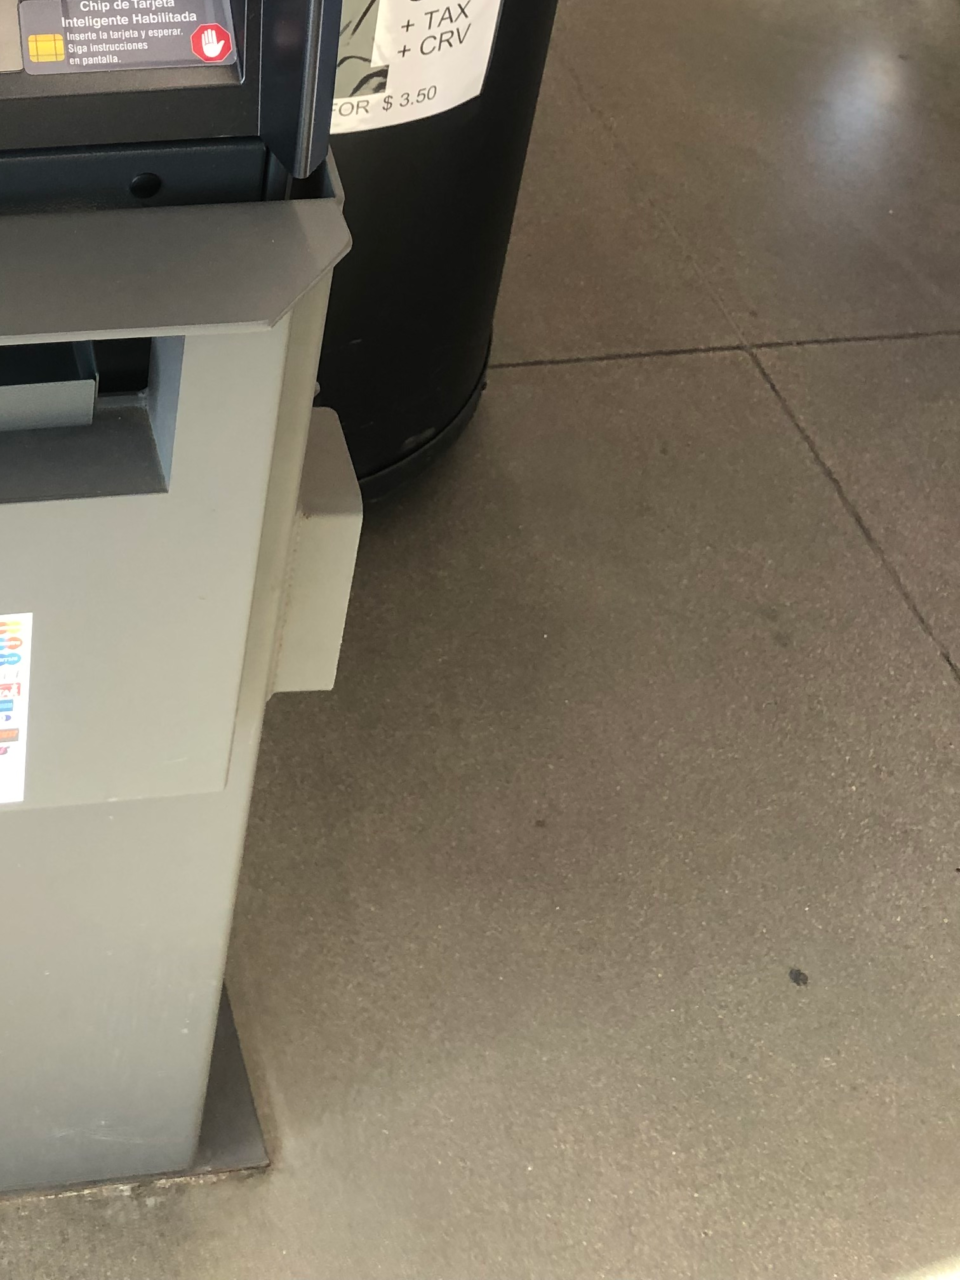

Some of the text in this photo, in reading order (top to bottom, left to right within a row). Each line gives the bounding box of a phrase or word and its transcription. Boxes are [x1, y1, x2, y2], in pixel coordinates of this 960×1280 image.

[79, 0, 111, 13] Chip
[61, 11, 197, 29] Inteligente Habilitada
[423, 0, 472, 31] TAX
[66, 27, 184, 41] Inserte la tarjeta y esperar.
[418, 23, 472, 56] CRV
[68, 41, 149, 54] Siga instrucciones
[69, 54, 122, 66] en pantalla.
[381, 94, 394, 112] $
[398, 84, 438, 108] 3.50
